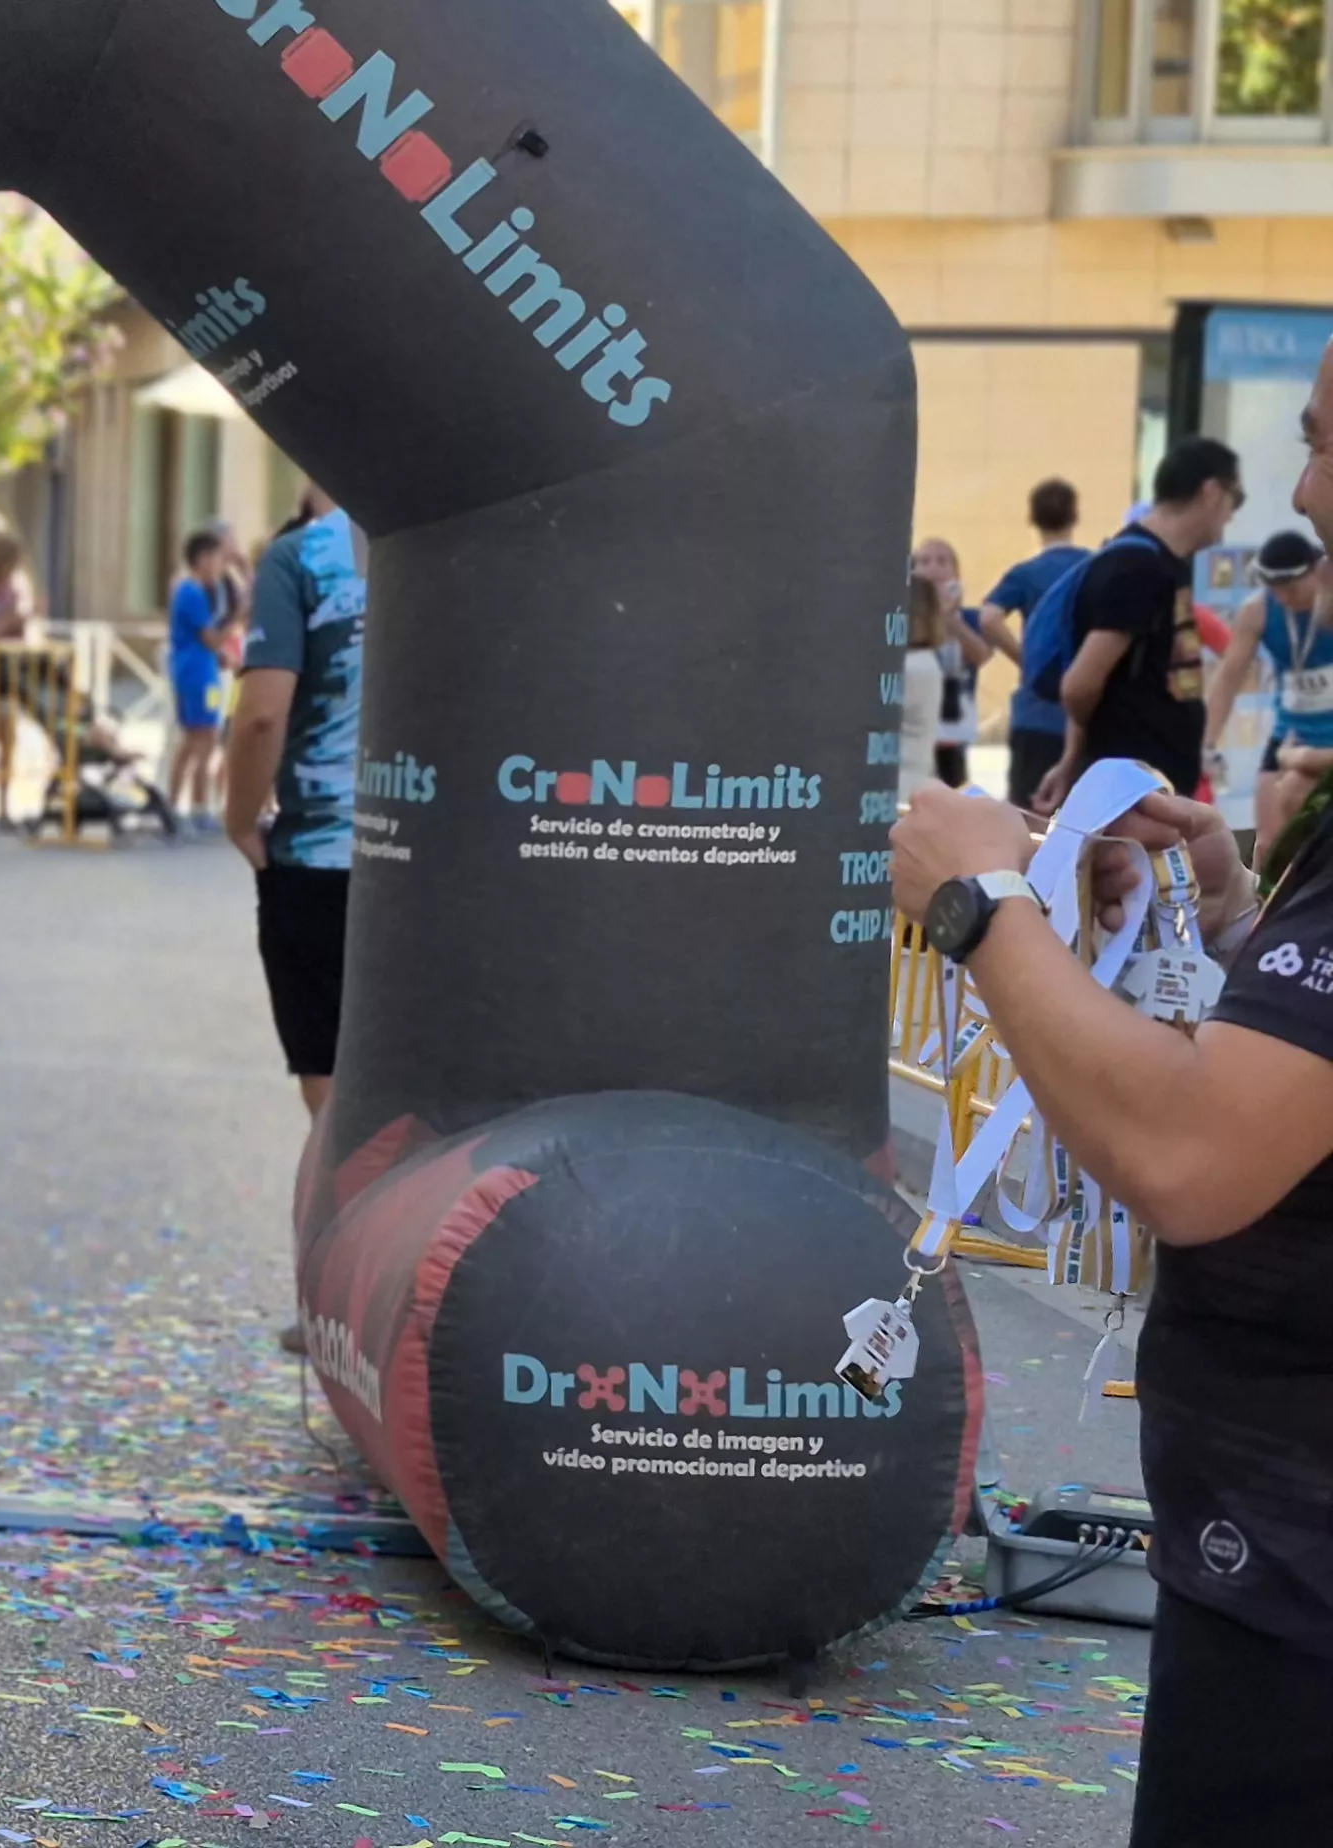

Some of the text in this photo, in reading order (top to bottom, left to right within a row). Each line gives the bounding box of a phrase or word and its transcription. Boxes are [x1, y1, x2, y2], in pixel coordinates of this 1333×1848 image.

[530, 814, 781, 843] Servicio de cronometraje y
[519, 841, 797, 866] gestión de eventos deportivos
[590, 1422, 824, 1455] Servicio de imagen y
[543, 1446, 867, 1481] vídeo promocional deportivo
